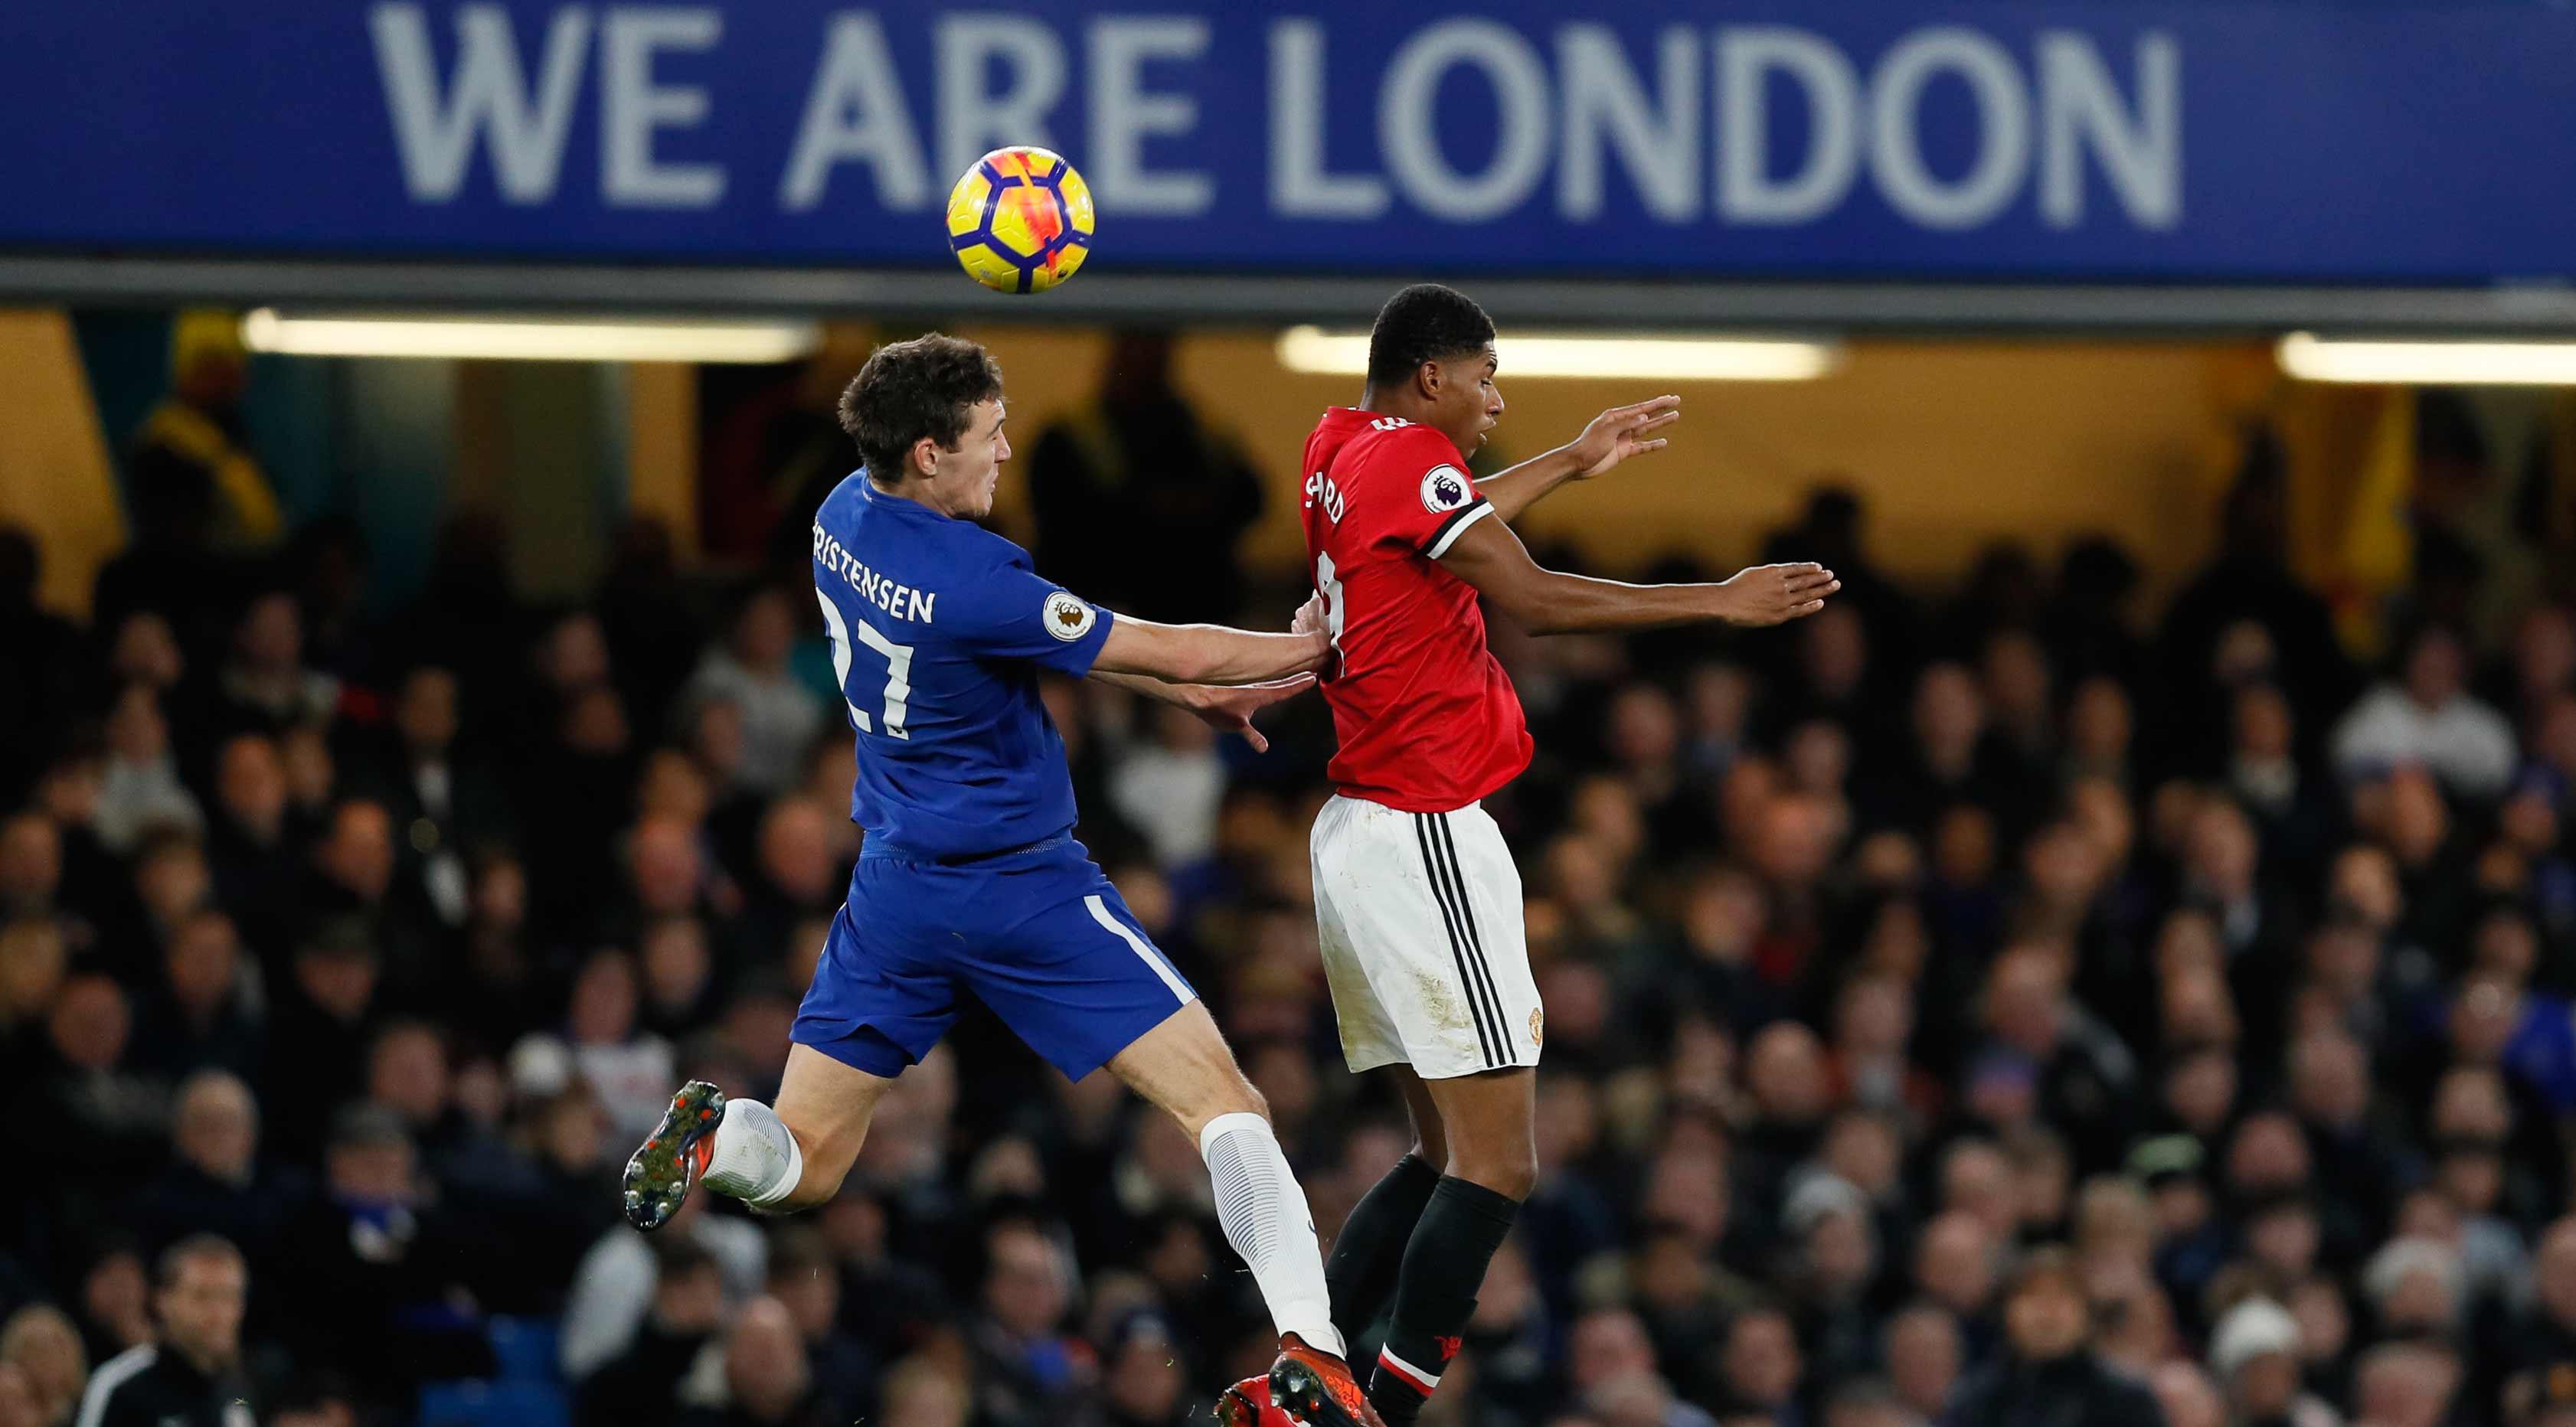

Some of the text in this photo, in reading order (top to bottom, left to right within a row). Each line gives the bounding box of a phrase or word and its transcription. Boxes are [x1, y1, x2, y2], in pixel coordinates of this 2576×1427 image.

[372, 3, 2182, 229] WE ARE LONDON
[812, 516, 936, 624] RISTENSEN
[816, 586, 914, 740] 27
